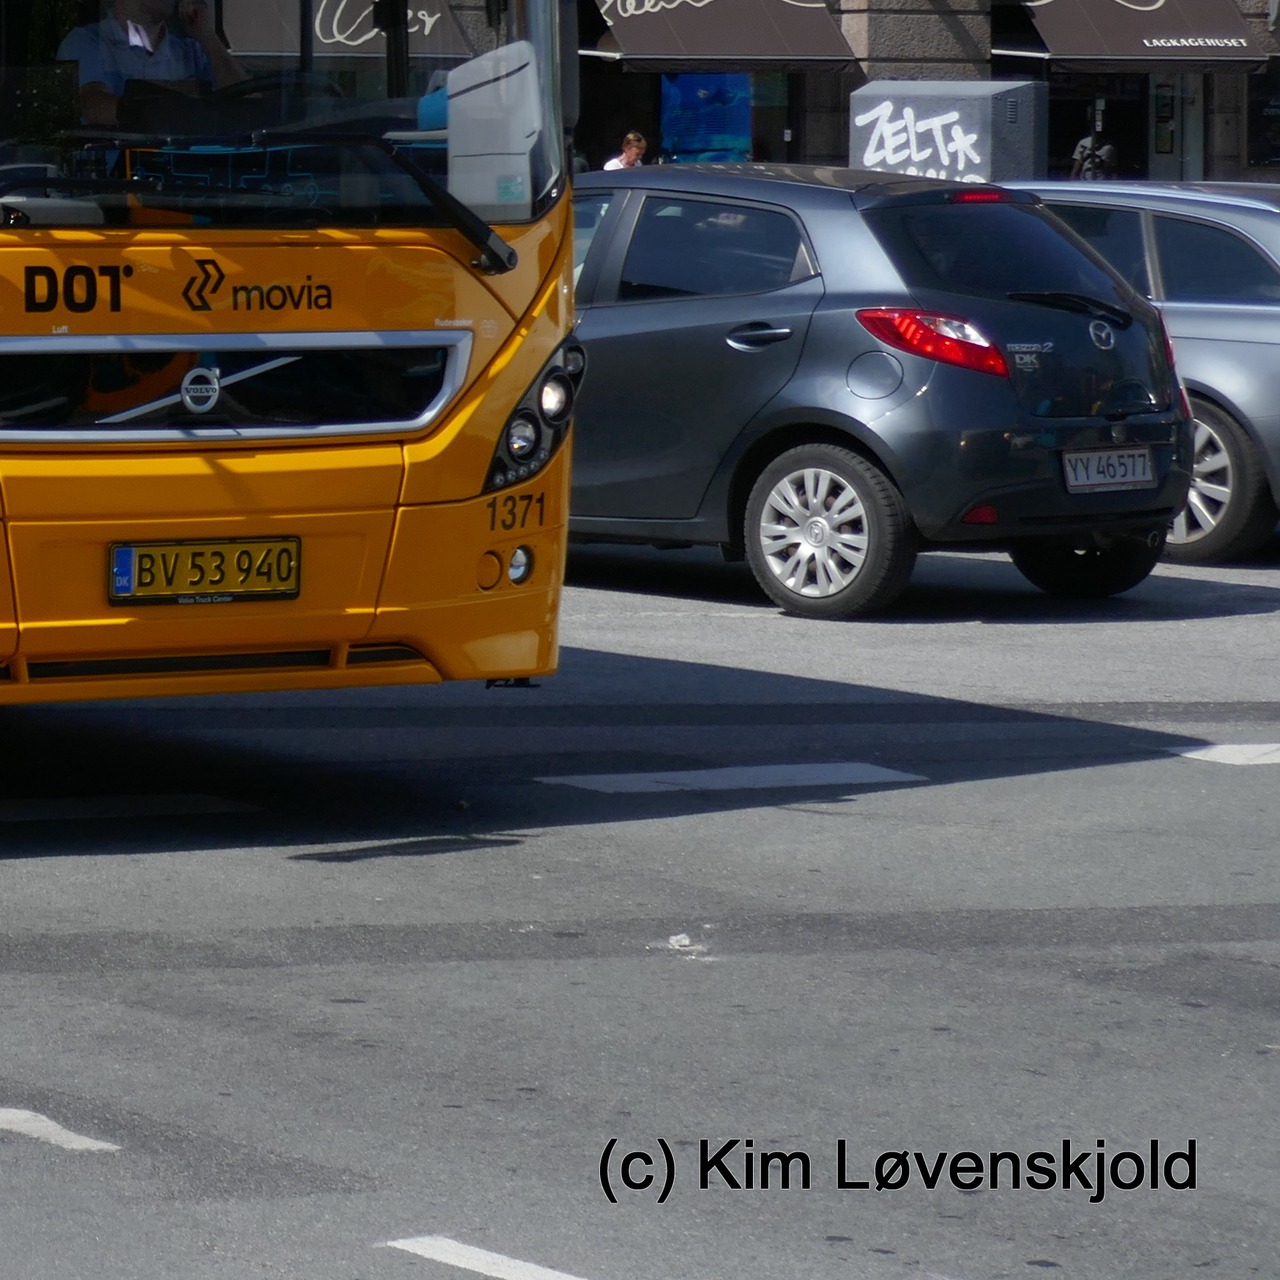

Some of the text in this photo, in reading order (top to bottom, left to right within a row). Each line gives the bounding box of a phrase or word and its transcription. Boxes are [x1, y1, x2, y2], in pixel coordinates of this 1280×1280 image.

[1143, 38, 1247, 48] LAGKAGEHUSET
[24, 265, 122, 313] DOT
[232, 275, 332, 310] movia
[52, 325, 69, 333] Luft
[1042, 342, 1054, 352] 2
[1015, 354, 1038, 363] DK
[1068, 457, 1090, 481] YY
[487, 492, 544, 531] 1371
[136, 547, 293, 587] BV 53 940
[116, 576, 129, 587] DK
[212, 595, 233, 603] Center
